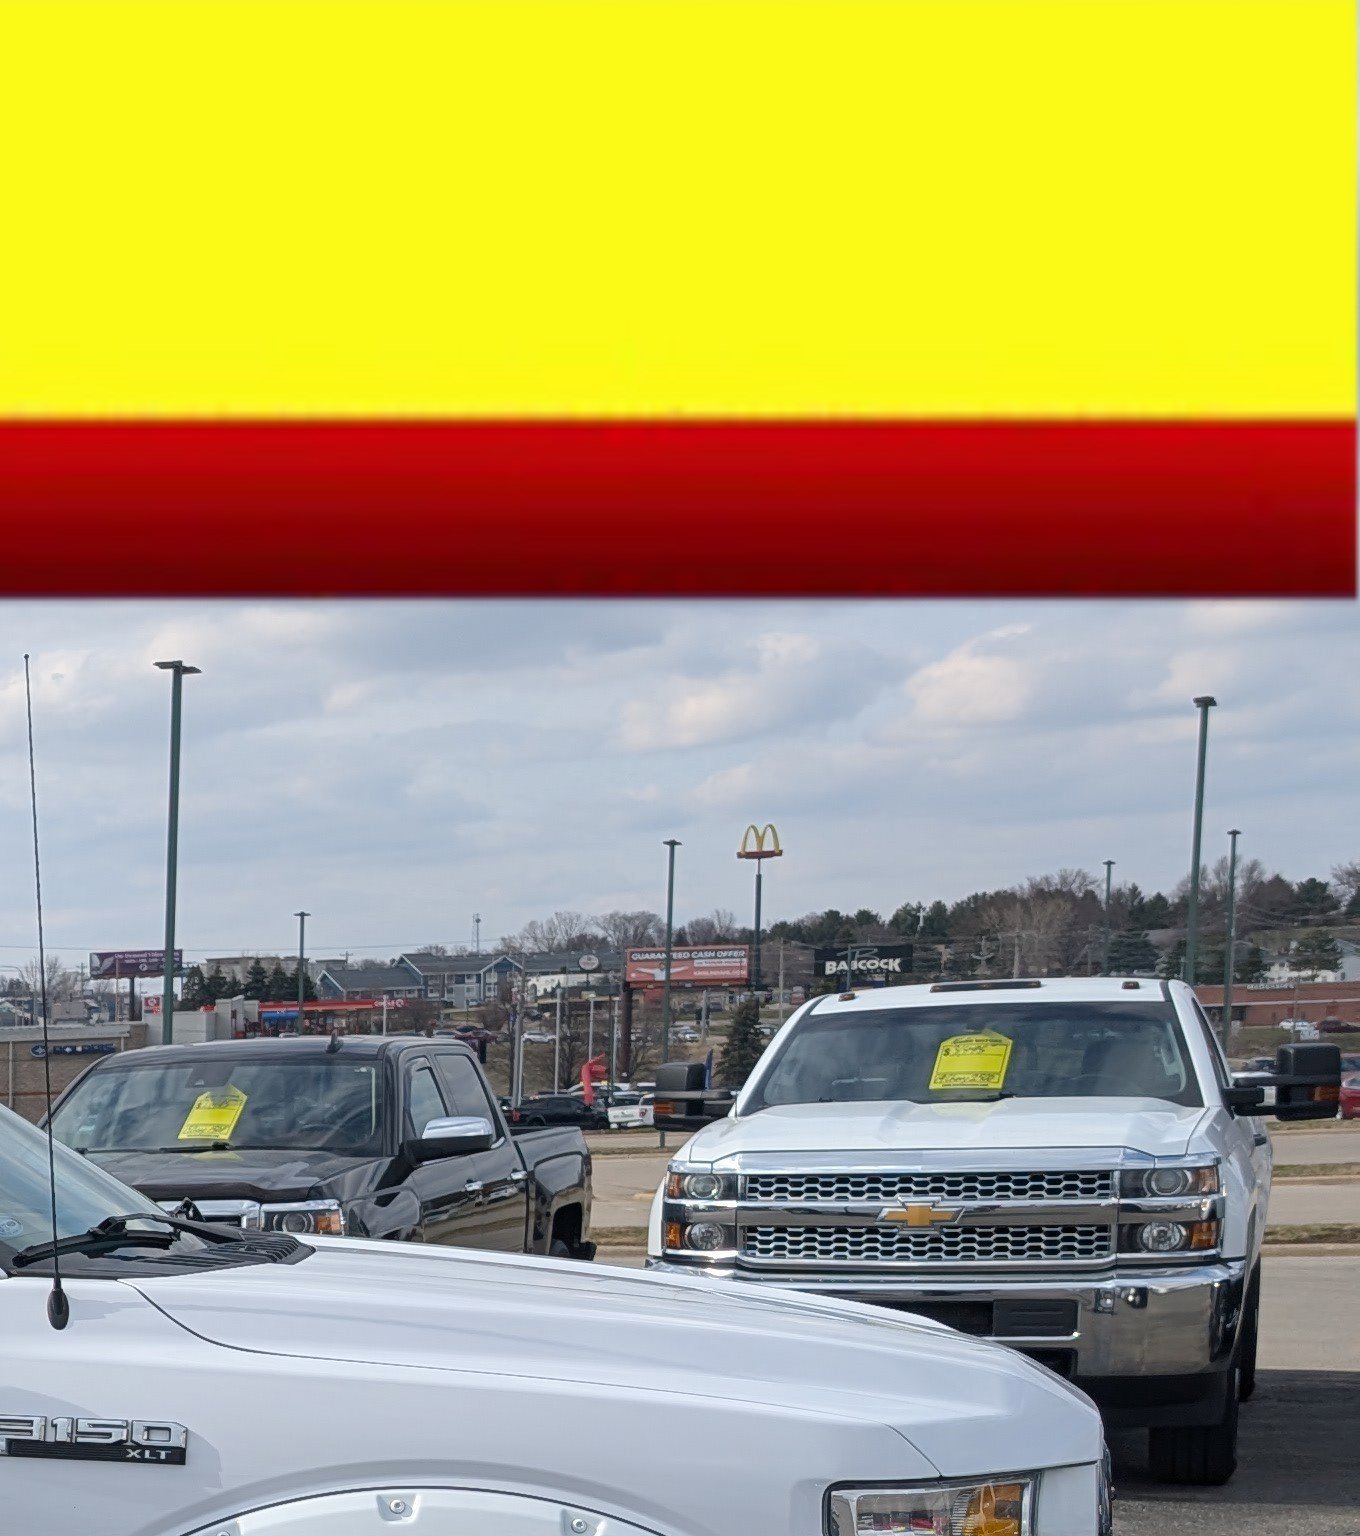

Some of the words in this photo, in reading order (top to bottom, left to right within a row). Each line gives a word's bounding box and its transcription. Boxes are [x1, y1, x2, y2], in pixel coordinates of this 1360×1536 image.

[632, 951, 690, 960] GUARANEED
[691, 951, 716, 959] CASH
[716, 950, 745, 959] OFFER
[125, 1449, 172, 1460] XLT
